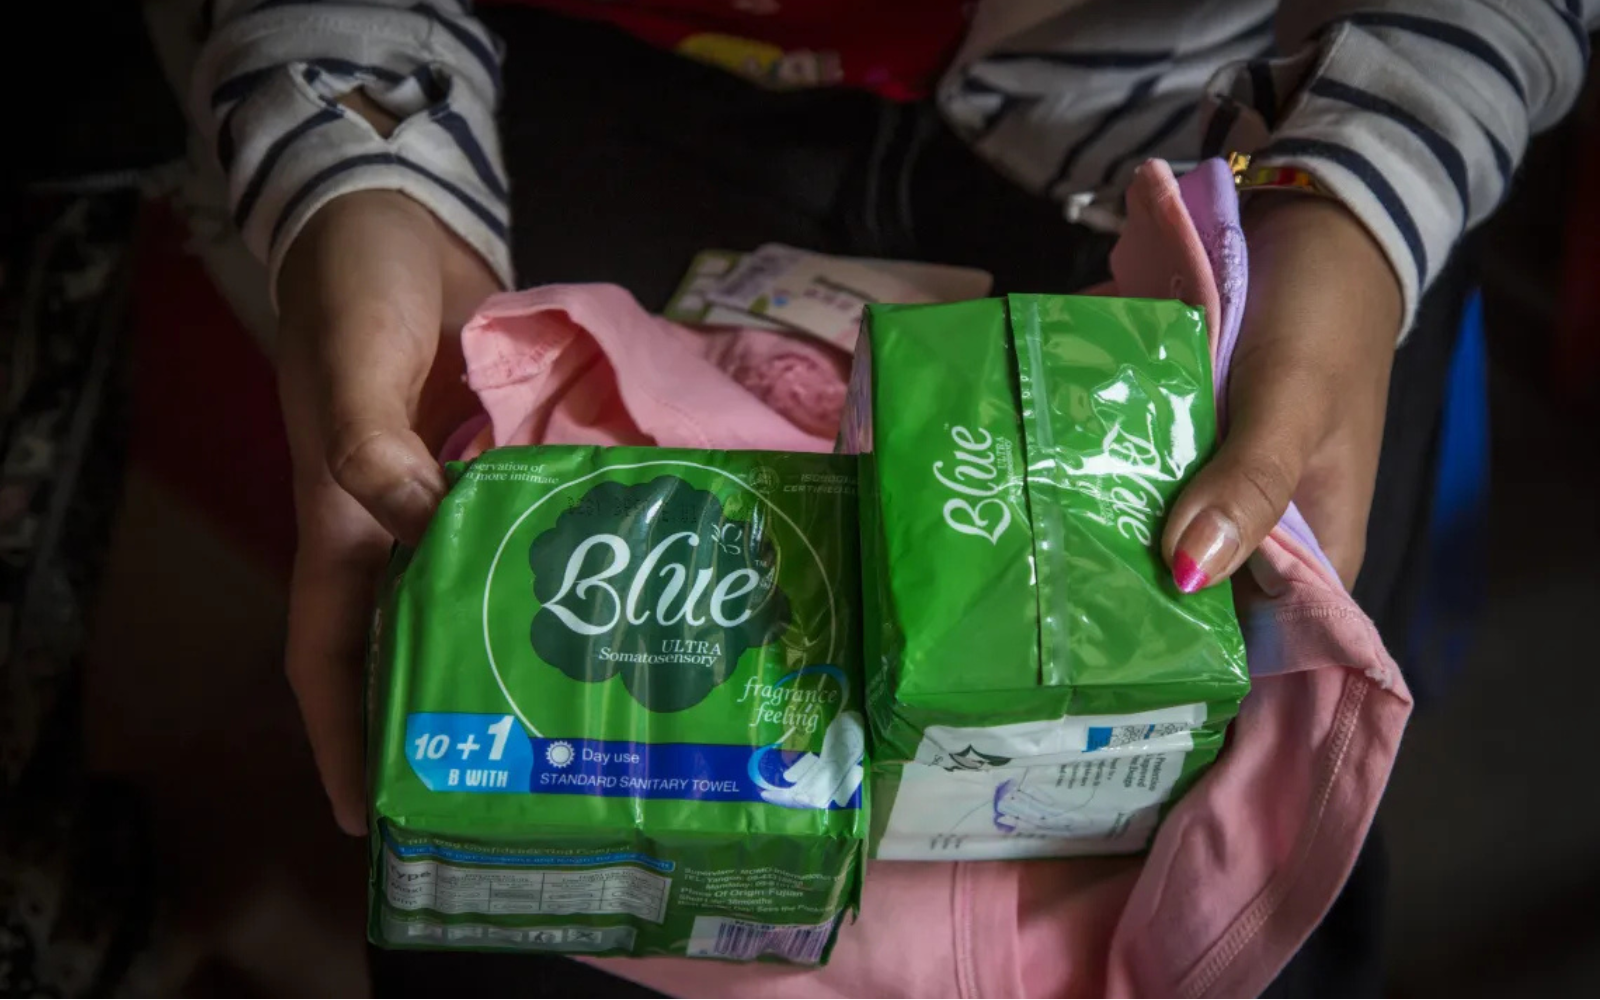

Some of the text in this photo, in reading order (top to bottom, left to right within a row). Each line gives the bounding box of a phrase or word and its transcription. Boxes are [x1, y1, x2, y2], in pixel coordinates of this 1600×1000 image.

[476, 471, 508, 481] more
[510, 471, 560, 484] intimate
[530, 464, 547, 474] of
[933, 425, 1011, 546] Blue
[540, 531, 760, 636] Blue
[598, 646, 718, 668] Somatosensory
[661, 639, 722, 656] ULTRA
[736, 675, 838, 706] fragrance
[748, 701, 819, 733] feeling
[582, 748, 641, 765] Day use
[448, 769, 509, 788] B WITH
[539, 772, 741, 793] STANDARD SANITARY TOWEL
